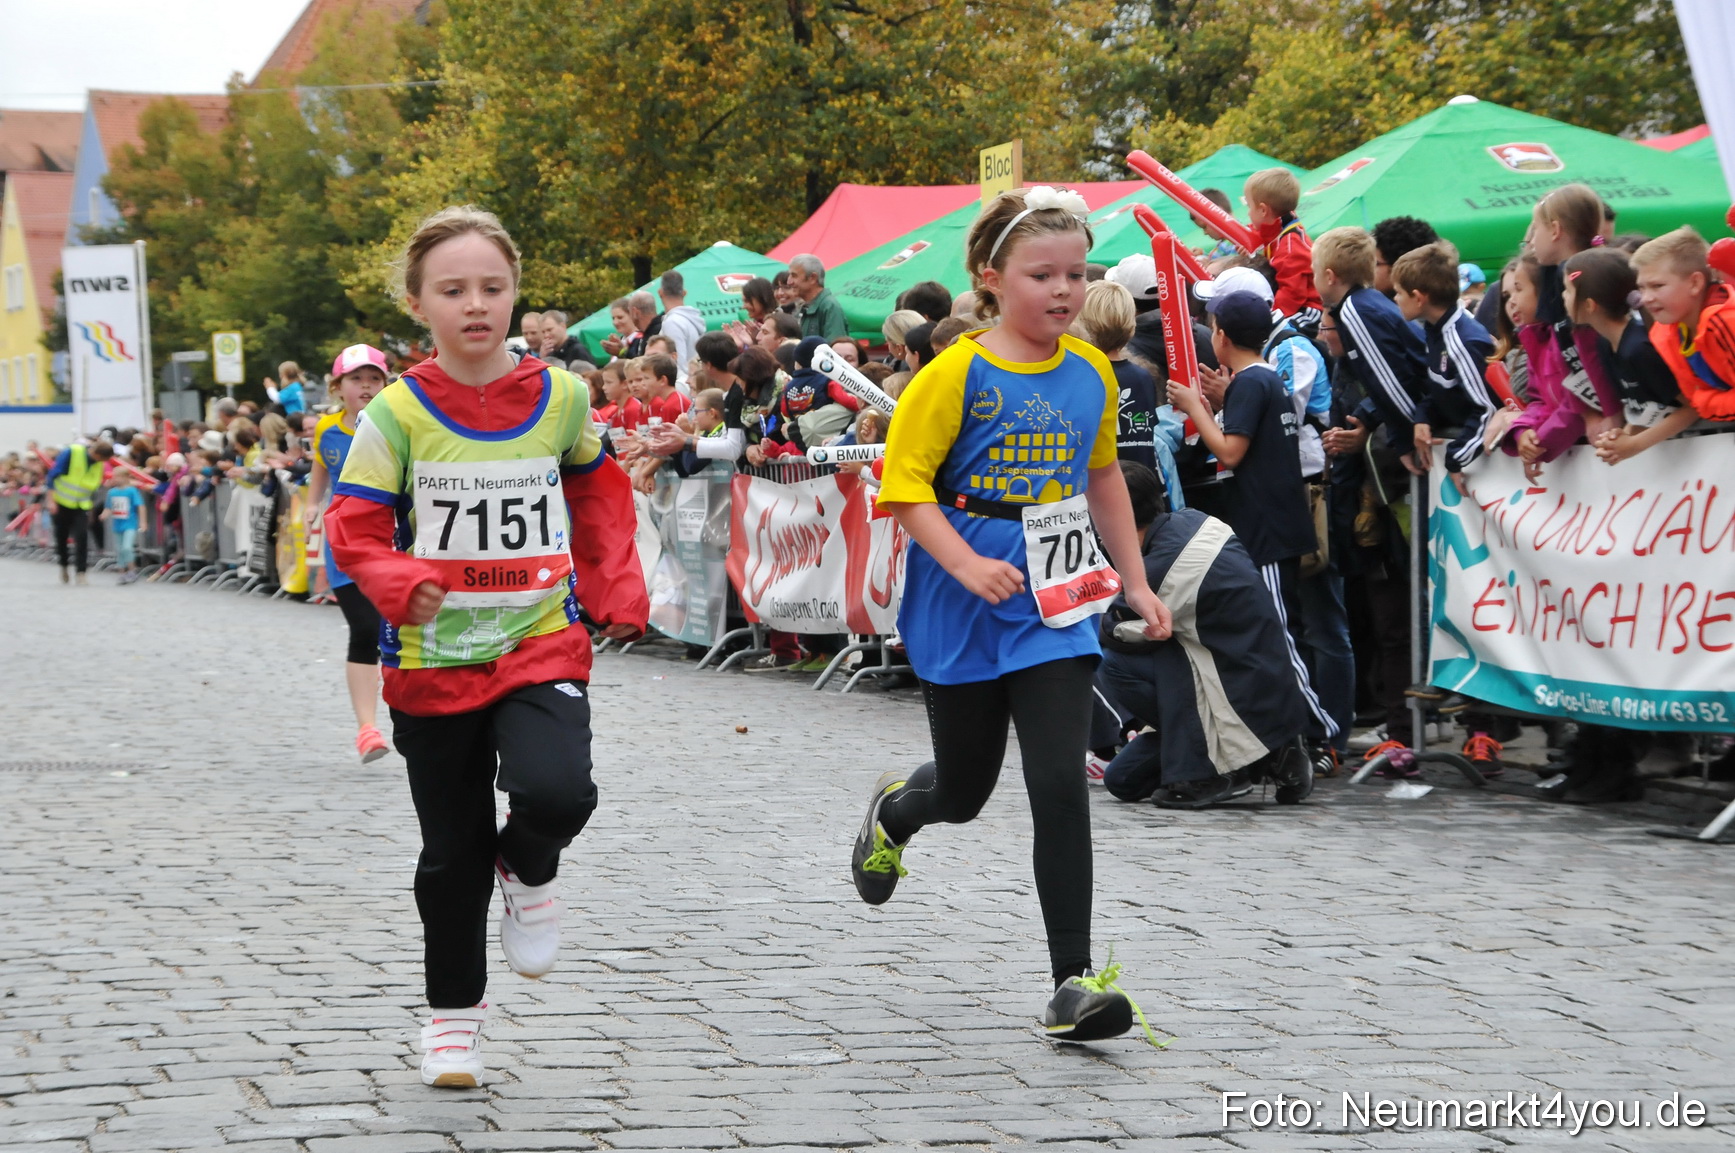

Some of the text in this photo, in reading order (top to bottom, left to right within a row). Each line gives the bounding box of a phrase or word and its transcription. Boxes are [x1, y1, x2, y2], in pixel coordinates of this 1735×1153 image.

[1161, 311, 1177, 371] Audi BKK
[836, 448, 870, 461] BMW
[418, 474, 542, 491] PARTL Neumarkt
[432, 494, 550, 551] 7151
[1026, 515, 1067, 531] PARTL
[463, 567, 528, 587] Selina
